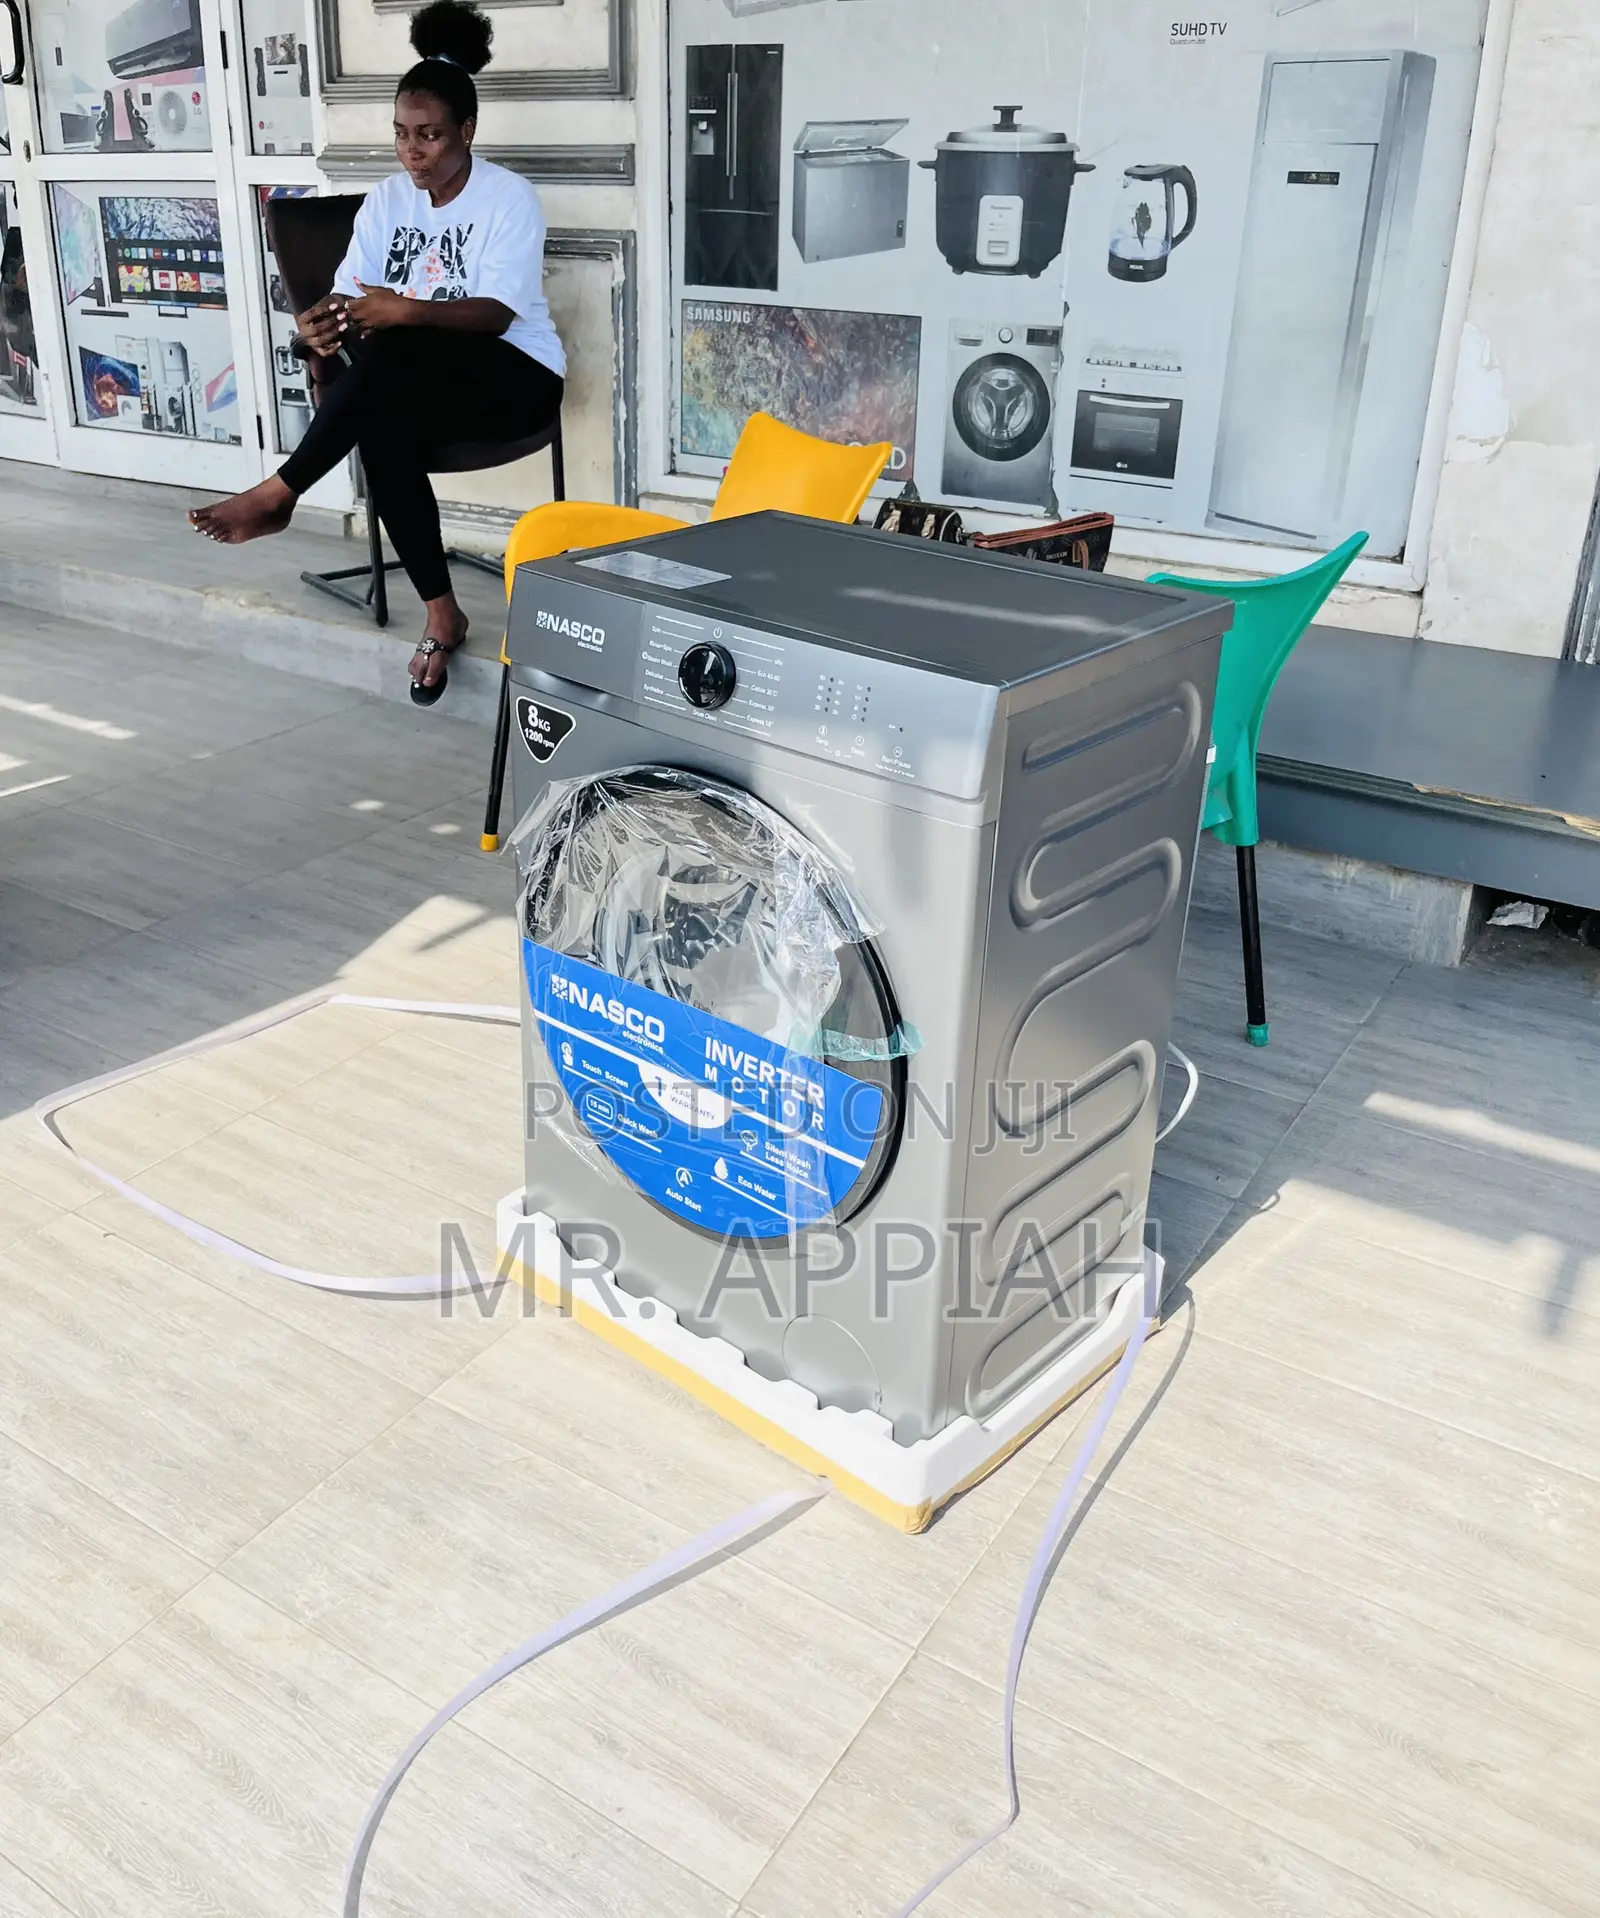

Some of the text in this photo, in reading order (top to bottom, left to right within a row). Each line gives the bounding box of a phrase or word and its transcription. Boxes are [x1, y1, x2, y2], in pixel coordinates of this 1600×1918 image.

[1170, 22, 1228, 36] SUHD TV
[385, 223, 475, 286] SPAK
[686, 306, 752, 324] SAMSUNG
[546, 613, 606, 646] NASCO
[568, 981, 666, 1044] NASCO
[621, 1029, 665, 1055] electronics
[581, 1059, 629, 1090] Touch Screen
[704, 1036, 825, 1111] INVERTER
[589, 1099, 611, 1115] 15 min
[616, 1112, 659, 1139] Quick Wash
[763, 1140, 812, 1171] Silent Wash
[764, 1150, 785, 1168] Less
[664, 1186, 703, 1213] Auto Start
[736, 1174, 778, 1202] Eco Water
